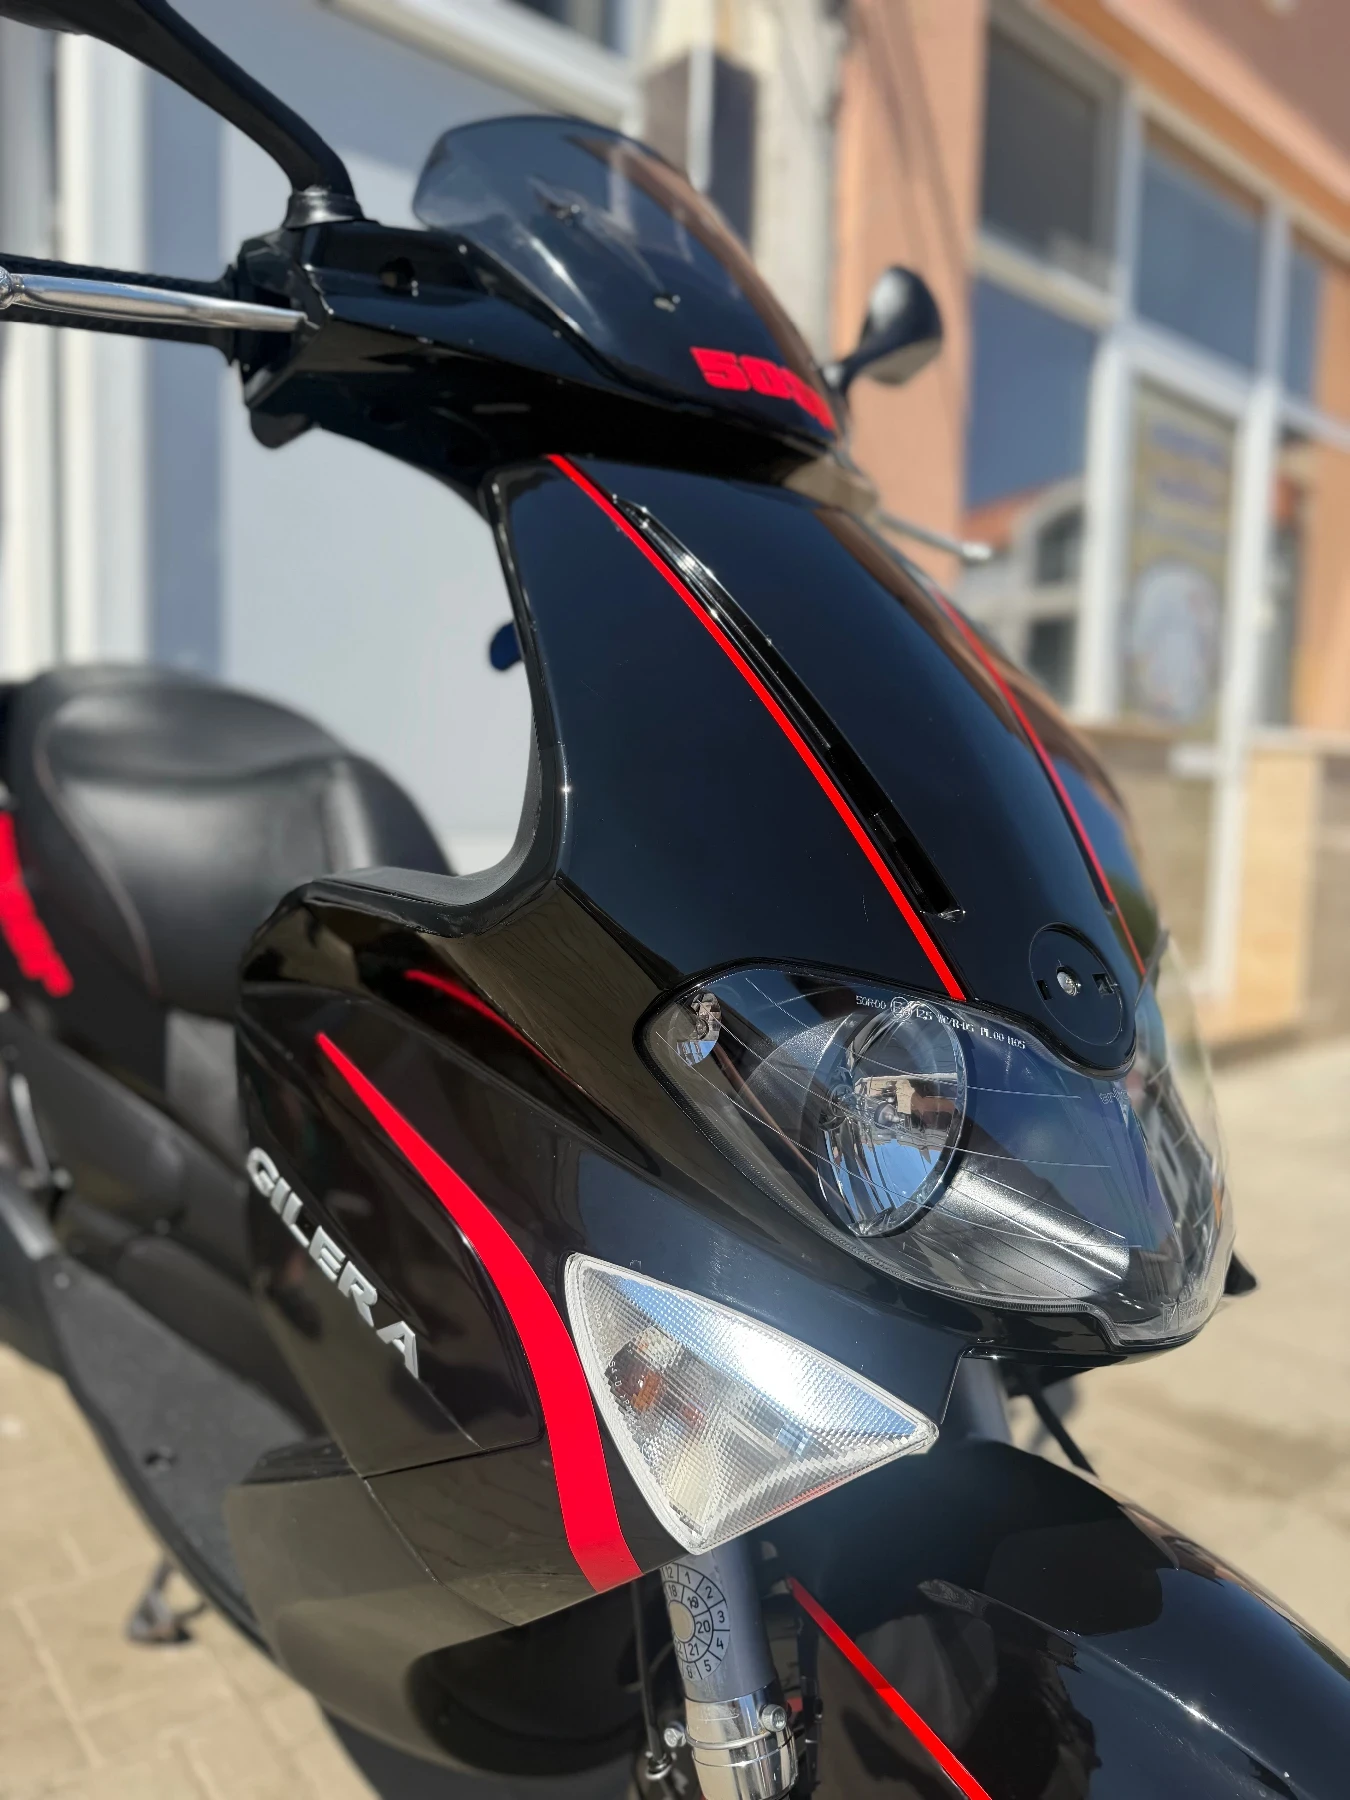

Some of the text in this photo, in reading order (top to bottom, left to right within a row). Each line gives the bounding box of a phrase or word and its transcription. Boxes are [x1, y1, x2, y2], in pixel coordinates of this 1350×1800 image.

[247, 1147, 419, 1379] GILERA
[705, 1586, 714, 1599] 2
[717, 1610, 725, 1623] 3
[695, 1619, 711, 1634] 20
[687, 1642, 700, 1656] 21
[716, 1637, 724, 1650] 4
[703, 1659, 712, 1673] 5
